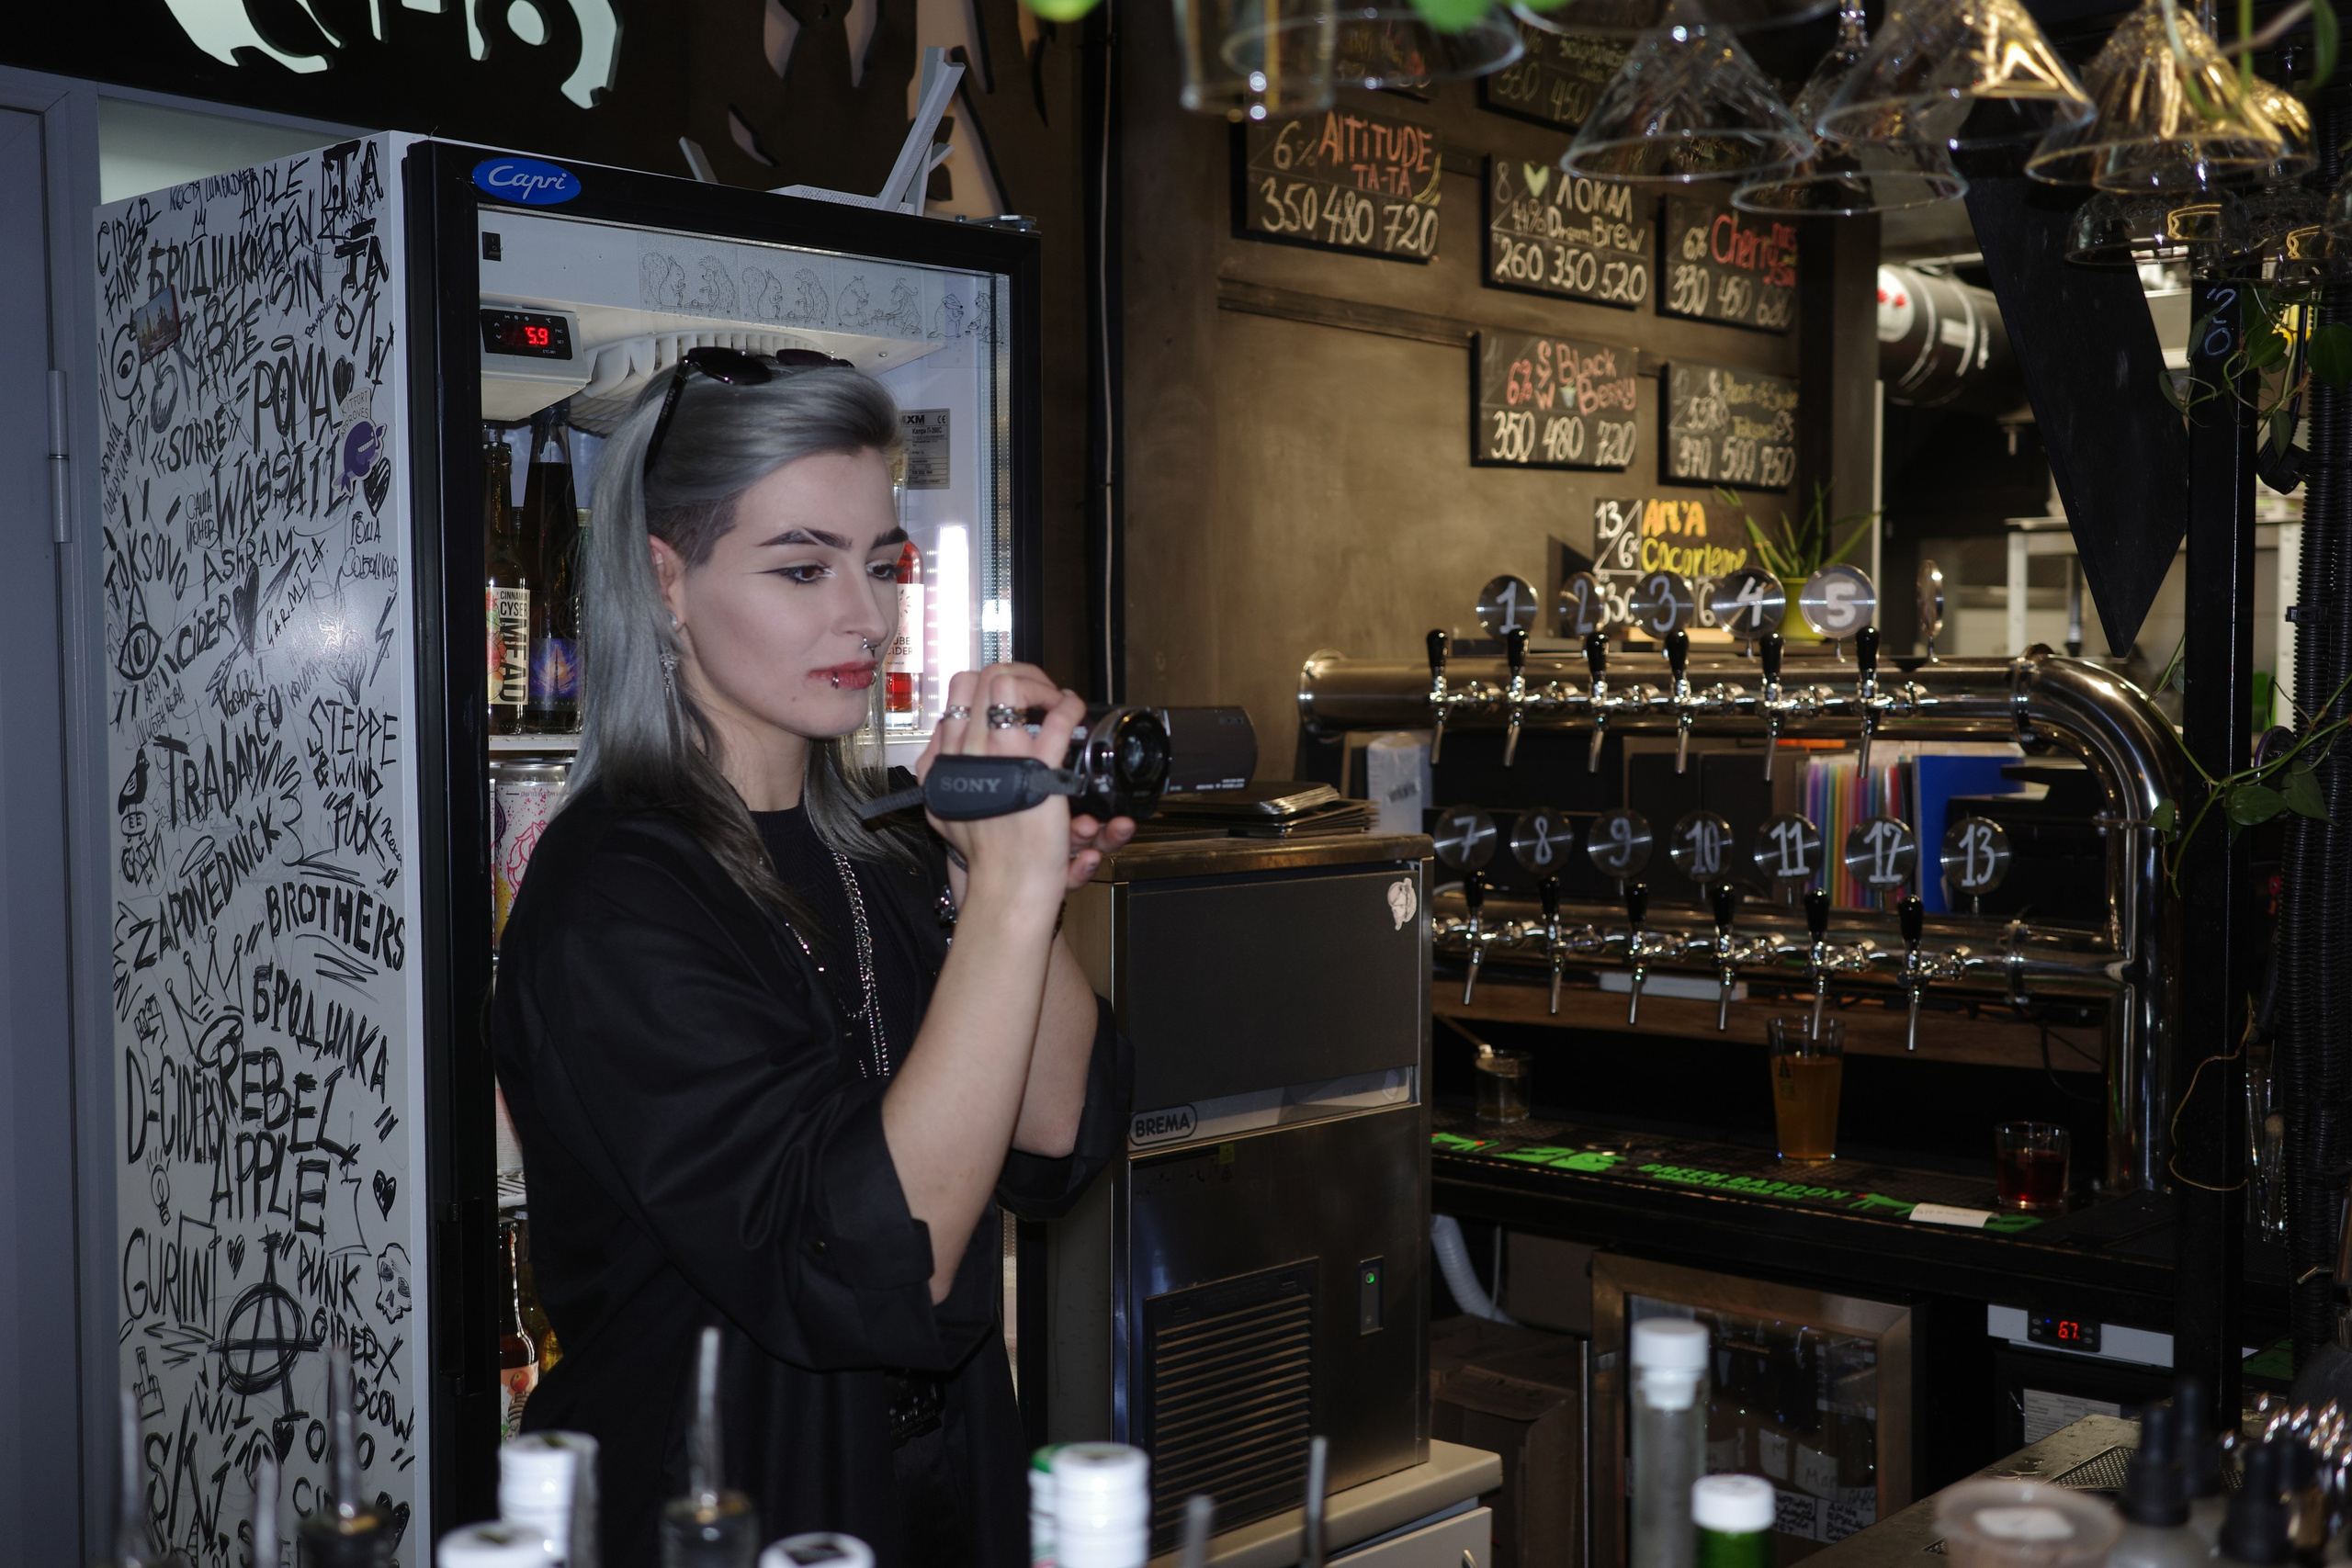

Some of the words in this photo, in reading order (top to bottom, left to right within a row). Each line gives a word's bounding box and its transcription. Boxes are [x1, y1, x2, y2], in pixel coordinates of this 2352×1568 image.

[239, 157, 310, 234] APPLE
[488, 165, 568, 199] Capri
[97, 197, 163, 276] CIDER
[1260, 176, 1317, 232] 350
[1322, 185, 1374, 244] 480
[1383, 203, 1439, 256] 720
[1496, 237, 1548, 282] 260
[1549, 244, 1597, 292] 350
[1598, 261, 1647, 302] 520
[340, 390, 368, 416] KITFORT
[340, 409, 369, 439] APPROVES
[1491, 411, 1536, 463] 350
[1543, 415, 1584, 461] 480
[1595, 501, 1623, 538] 13
[1496, 580, 1521, 635] 1
[1573, 579, 1594, 635] 2
[1649, 575, 1678, 632] 3
[1736, 577, 1764, 627] 4
[1825, 582, 1858, 626] 5
[499, 617, 526, 705] MEAD
[309, 695, 398, 770] STEPPE
[332, 758, 384, 801] WIND
[941, 776, 1001, 794] SONY
[1534, 817, 1553, 865] 8
[1609, 817, 1632, 866] 9
[1685, 820, 1720, 874] 10
[1770, 814, 1812, 877] 11
[1865, 821, 1904, 884] 12
[1957, 824, 1996, 887] 13
[266, 881, 405, 972] BROTHERS
[213, 1036, 361, 1171] REBEL
[1135, 1113, 1191, 1138] BREMA
[210, 1122, 332, 1247] APPLE
